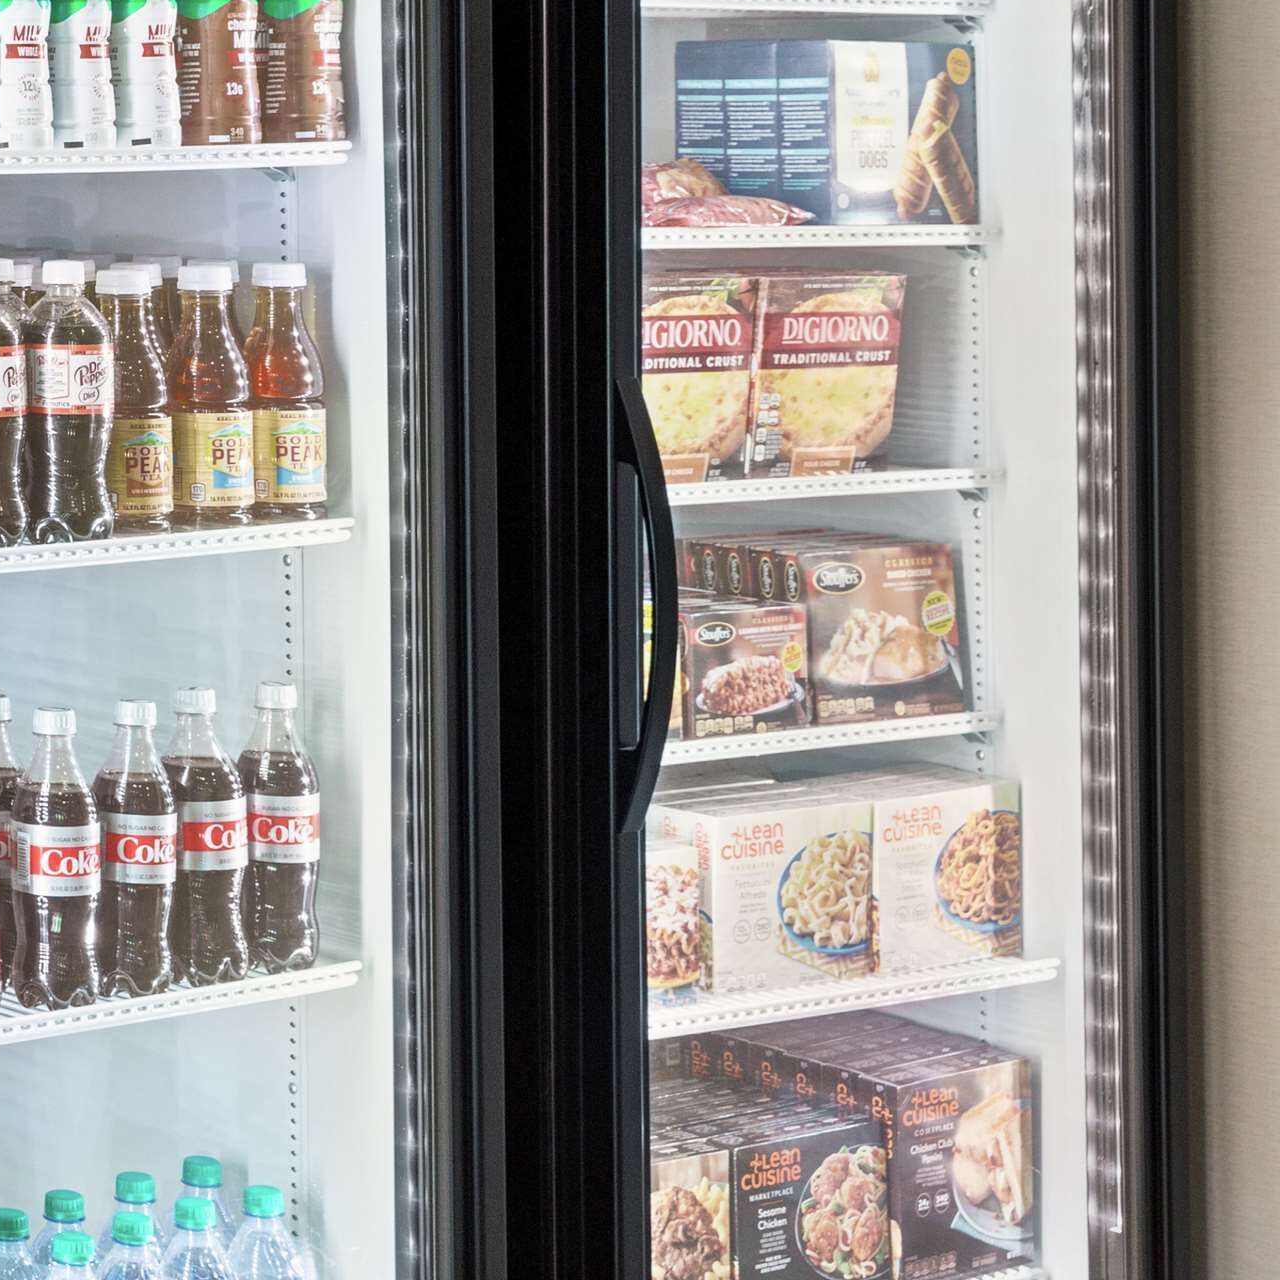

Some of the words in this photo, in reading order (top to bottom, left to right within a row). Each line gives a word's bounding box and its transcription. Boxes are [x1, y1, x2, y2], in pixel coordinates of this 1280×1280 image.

[642, 319, 741, 349] IGIORNO
[642, 355, 703, 370] DITIONAL
[706, 355, 745, 368] CRUST
[773, 352, 852, 365] TRADITIONAL
[855, 350, 891, 362] CRUST
[276, 445, 323, 462] PEAK
[140, 473, 162, 481] TEA
[252, 816, 314, 844] Coke
[744, 822, 784, 842] Lean
[117, 836, 175, 864] Coke
[41, 848, 100, 877] Coke
[762, 1147, 801, 1170] Lean
[741, 1163, 802, 1191] Cuisine
